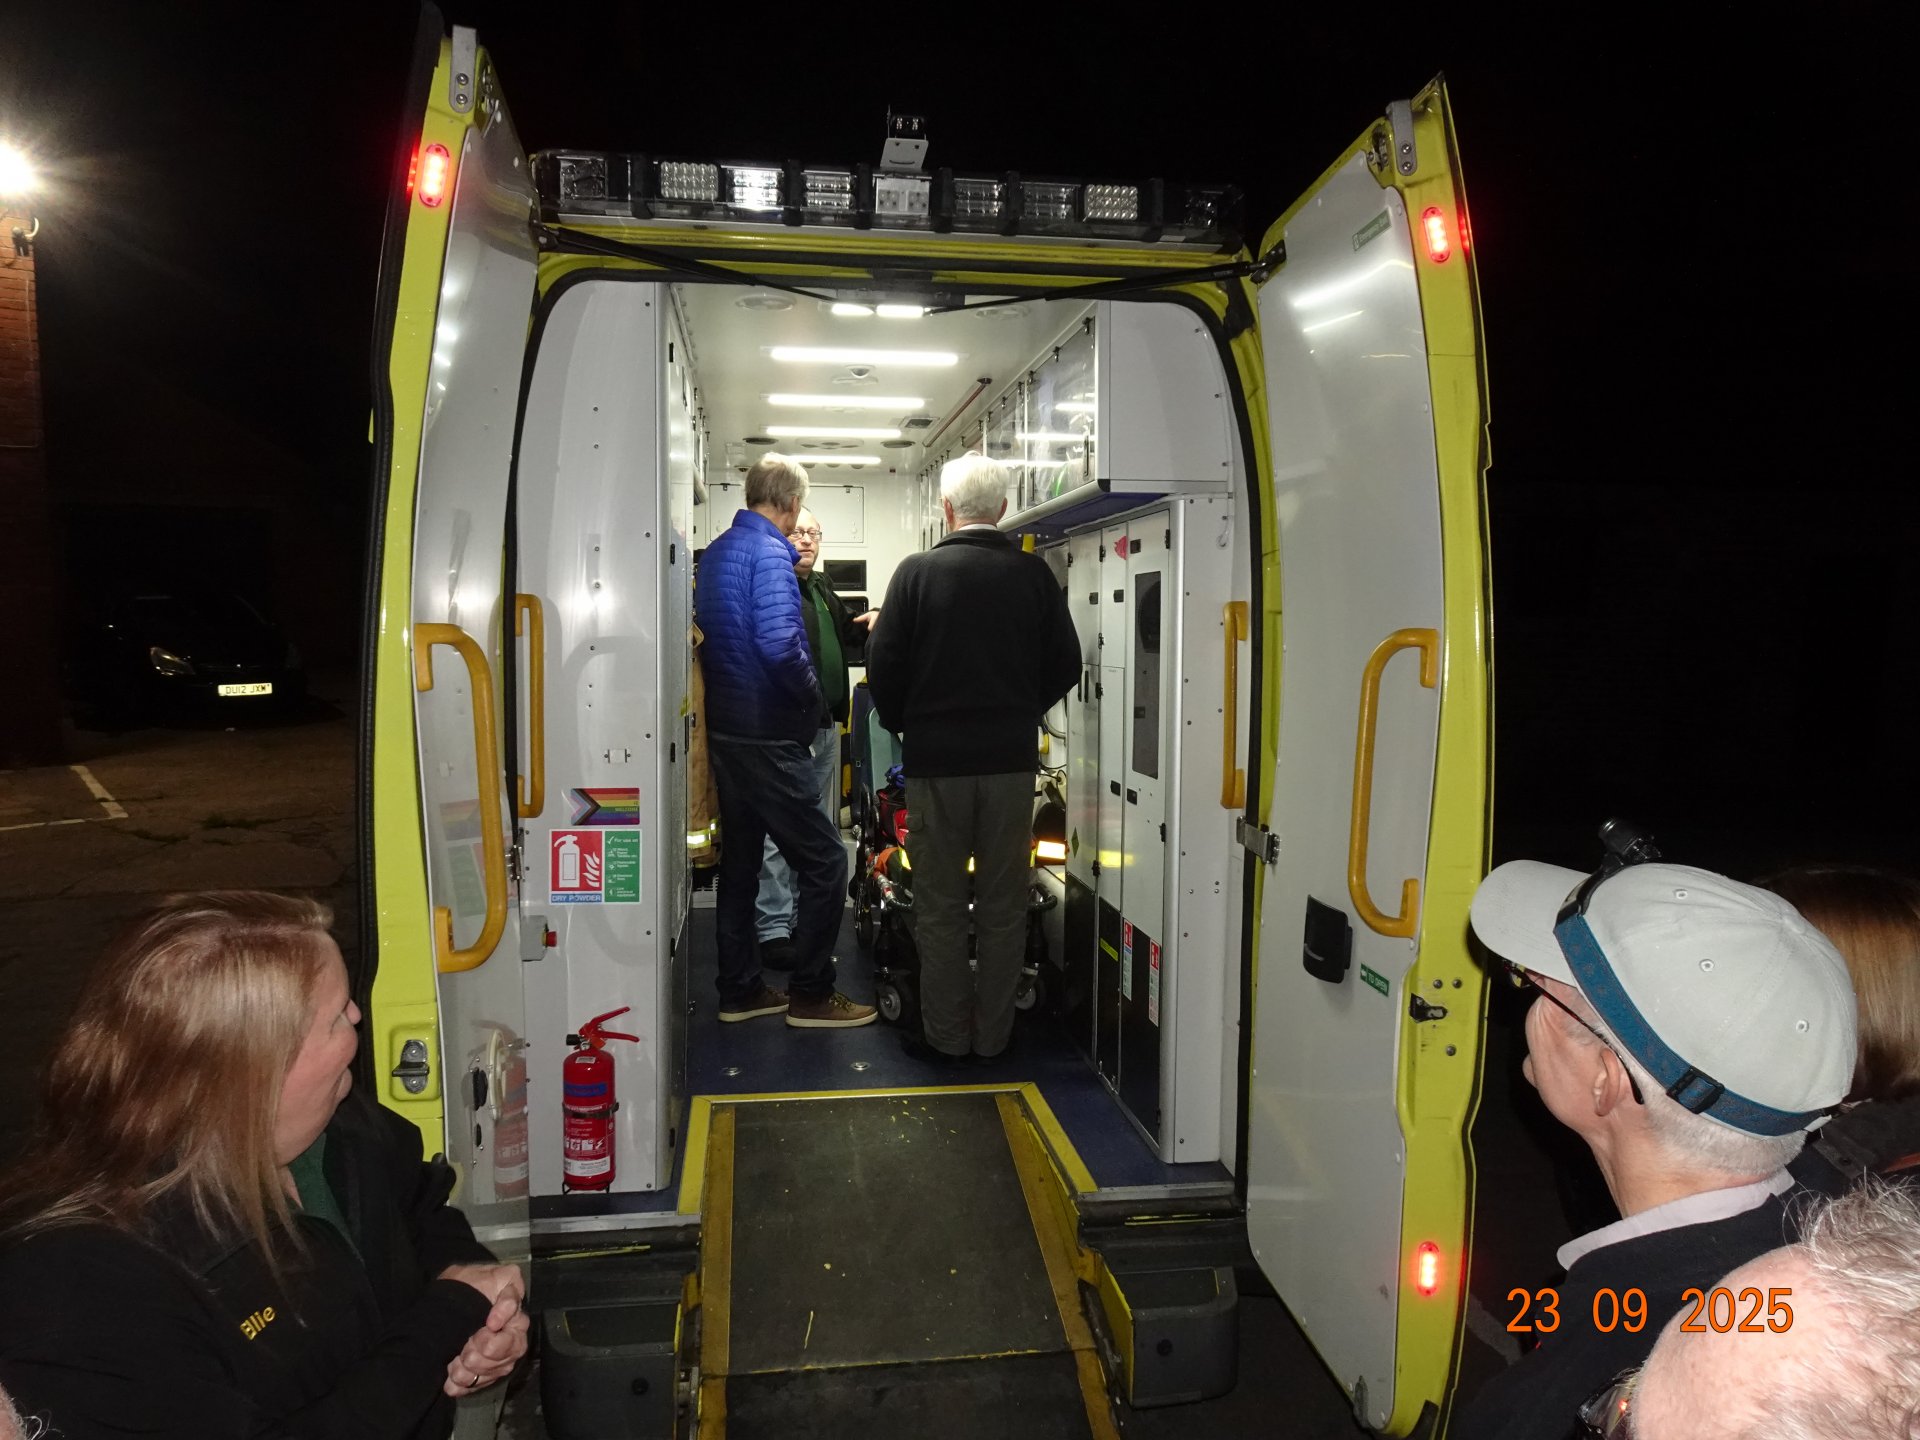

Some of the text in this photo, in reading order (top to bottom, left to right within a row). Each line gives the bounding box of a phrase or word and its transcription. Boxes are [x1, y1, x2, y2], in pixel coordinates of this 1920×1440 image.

[552, 894, 601, 902] DRY POWDER
[240, 1306, 276, 1340] Ellie
